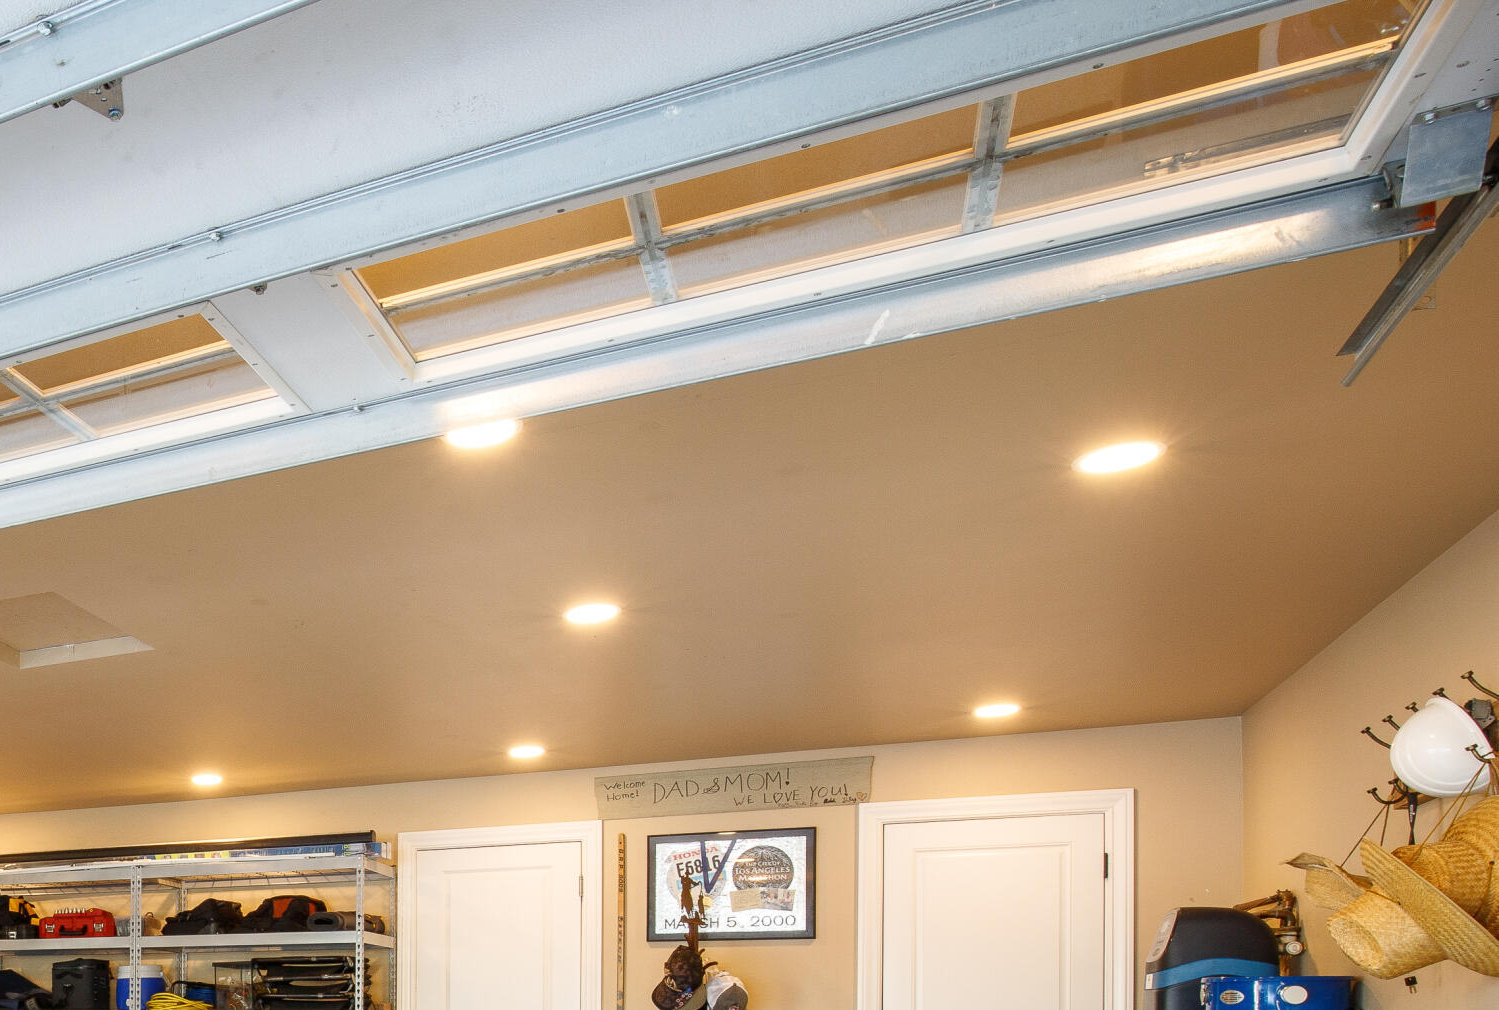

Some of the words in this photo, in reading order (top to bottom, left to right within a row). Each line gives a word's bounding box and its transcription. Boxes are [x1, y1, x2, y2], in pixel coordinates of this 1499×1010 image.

[603, 780, 646, 791] Welcome
[652, 780, 700, 804] DAD
[724, 767, 790, 793] MOM!
[606, 789, 640, 802] Home!
[733, 794, 755, 807] WE
[763, 789, 802, 804] LOVE
[809, 783, 849, 801] YOU!
[735, 867, 751, 875] LOS
[750, 866, 791, 875] ANGELES
[664, 917, 720, 930] MACH
[750, 914, 797, 927] 2000
